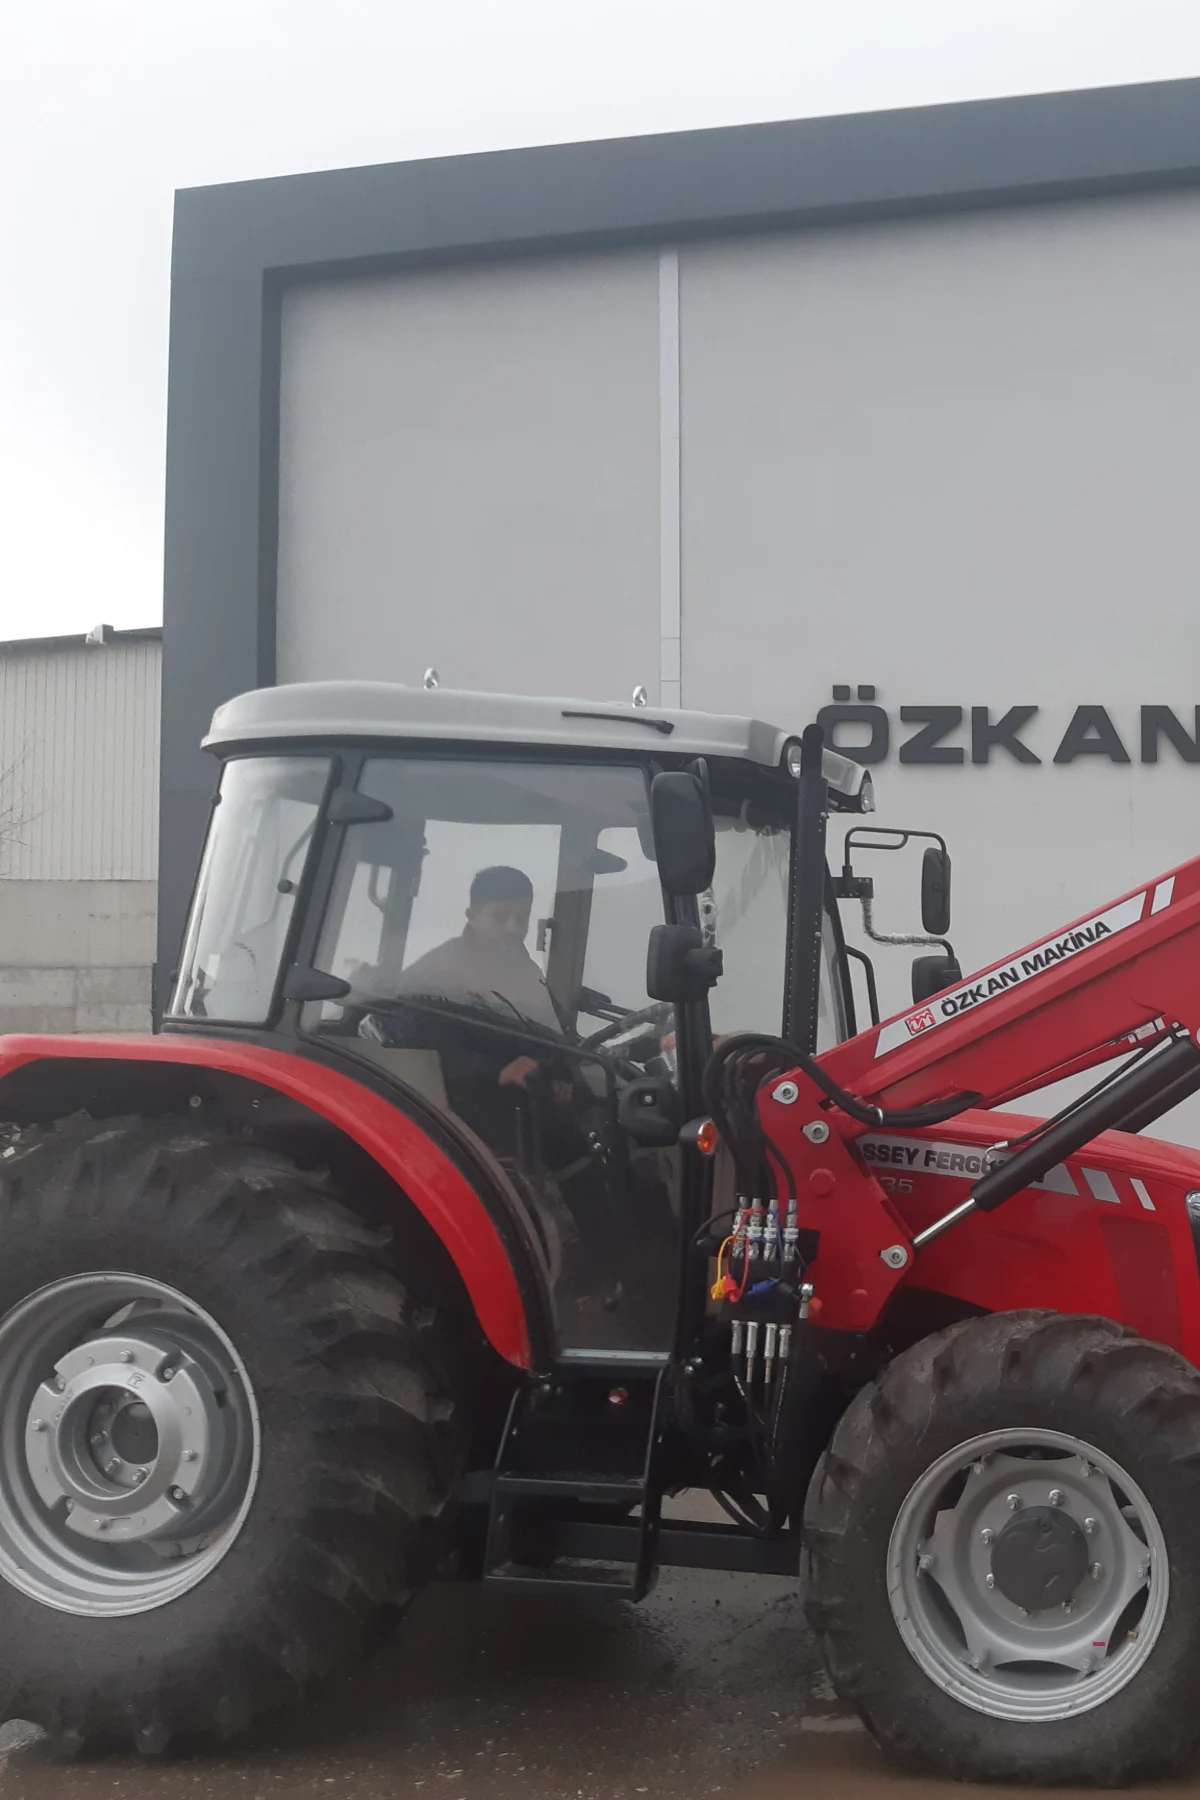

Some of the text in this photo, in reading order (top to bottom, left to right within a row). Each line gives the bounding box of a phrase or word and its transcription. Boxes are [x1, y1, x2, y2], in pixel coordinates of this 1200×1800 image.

[941, 921, 1112, 1017] ÖZKAN MAKİNA
[862, 1143, 920, 1165] SSEY
